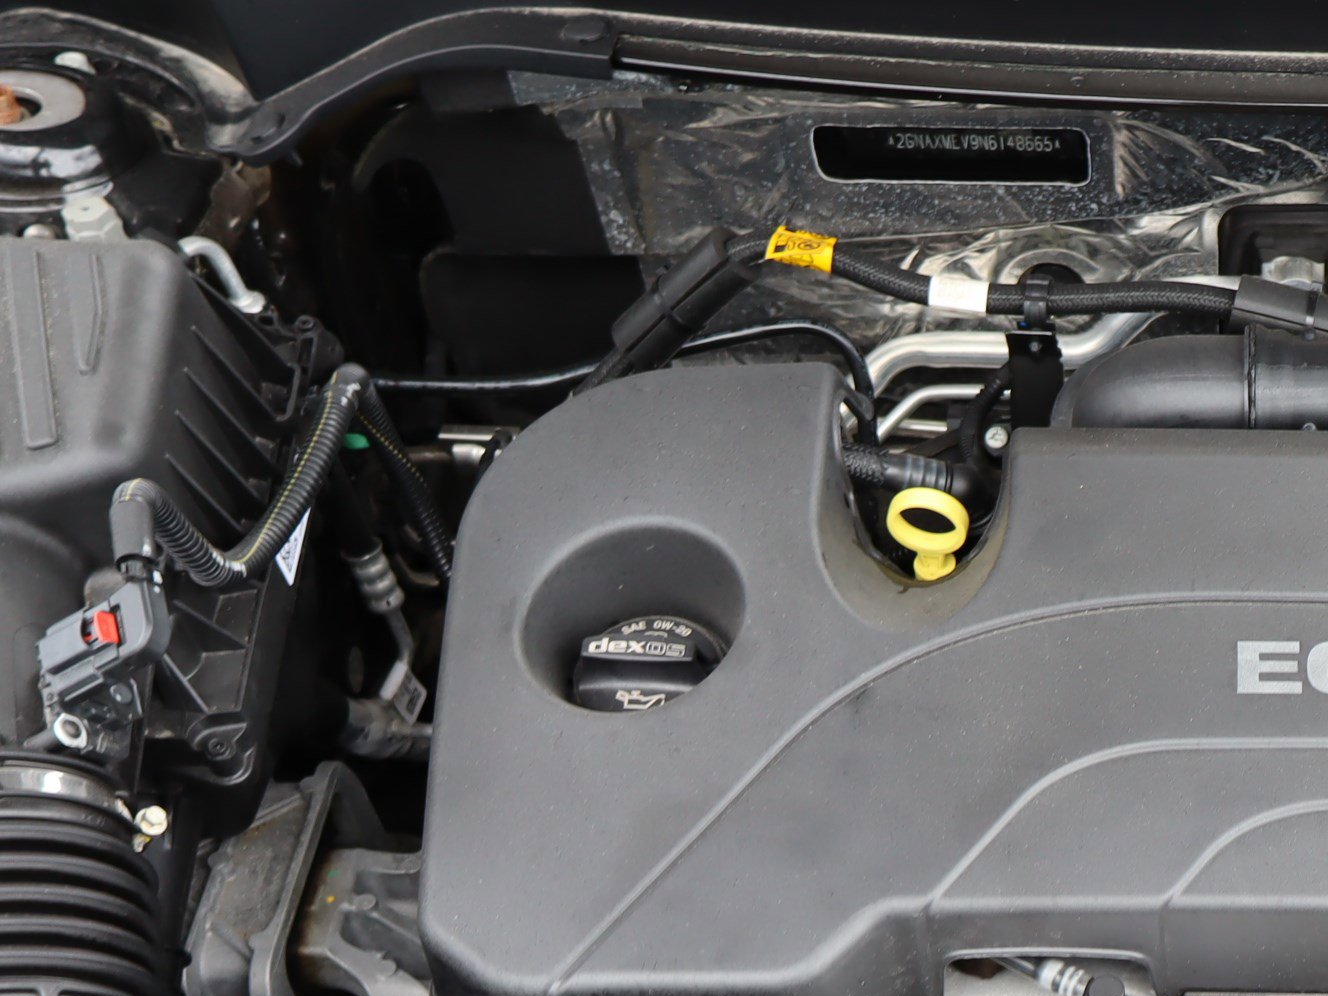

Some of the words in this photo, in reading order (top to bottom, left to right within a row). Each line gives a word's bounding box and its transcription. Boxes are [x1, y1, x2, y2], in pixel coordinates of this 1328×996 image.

[621, 620, 646, 635] SAE
[653, 620, 692, 637] 0W-20
[588, 637, 686, 657] dexos
